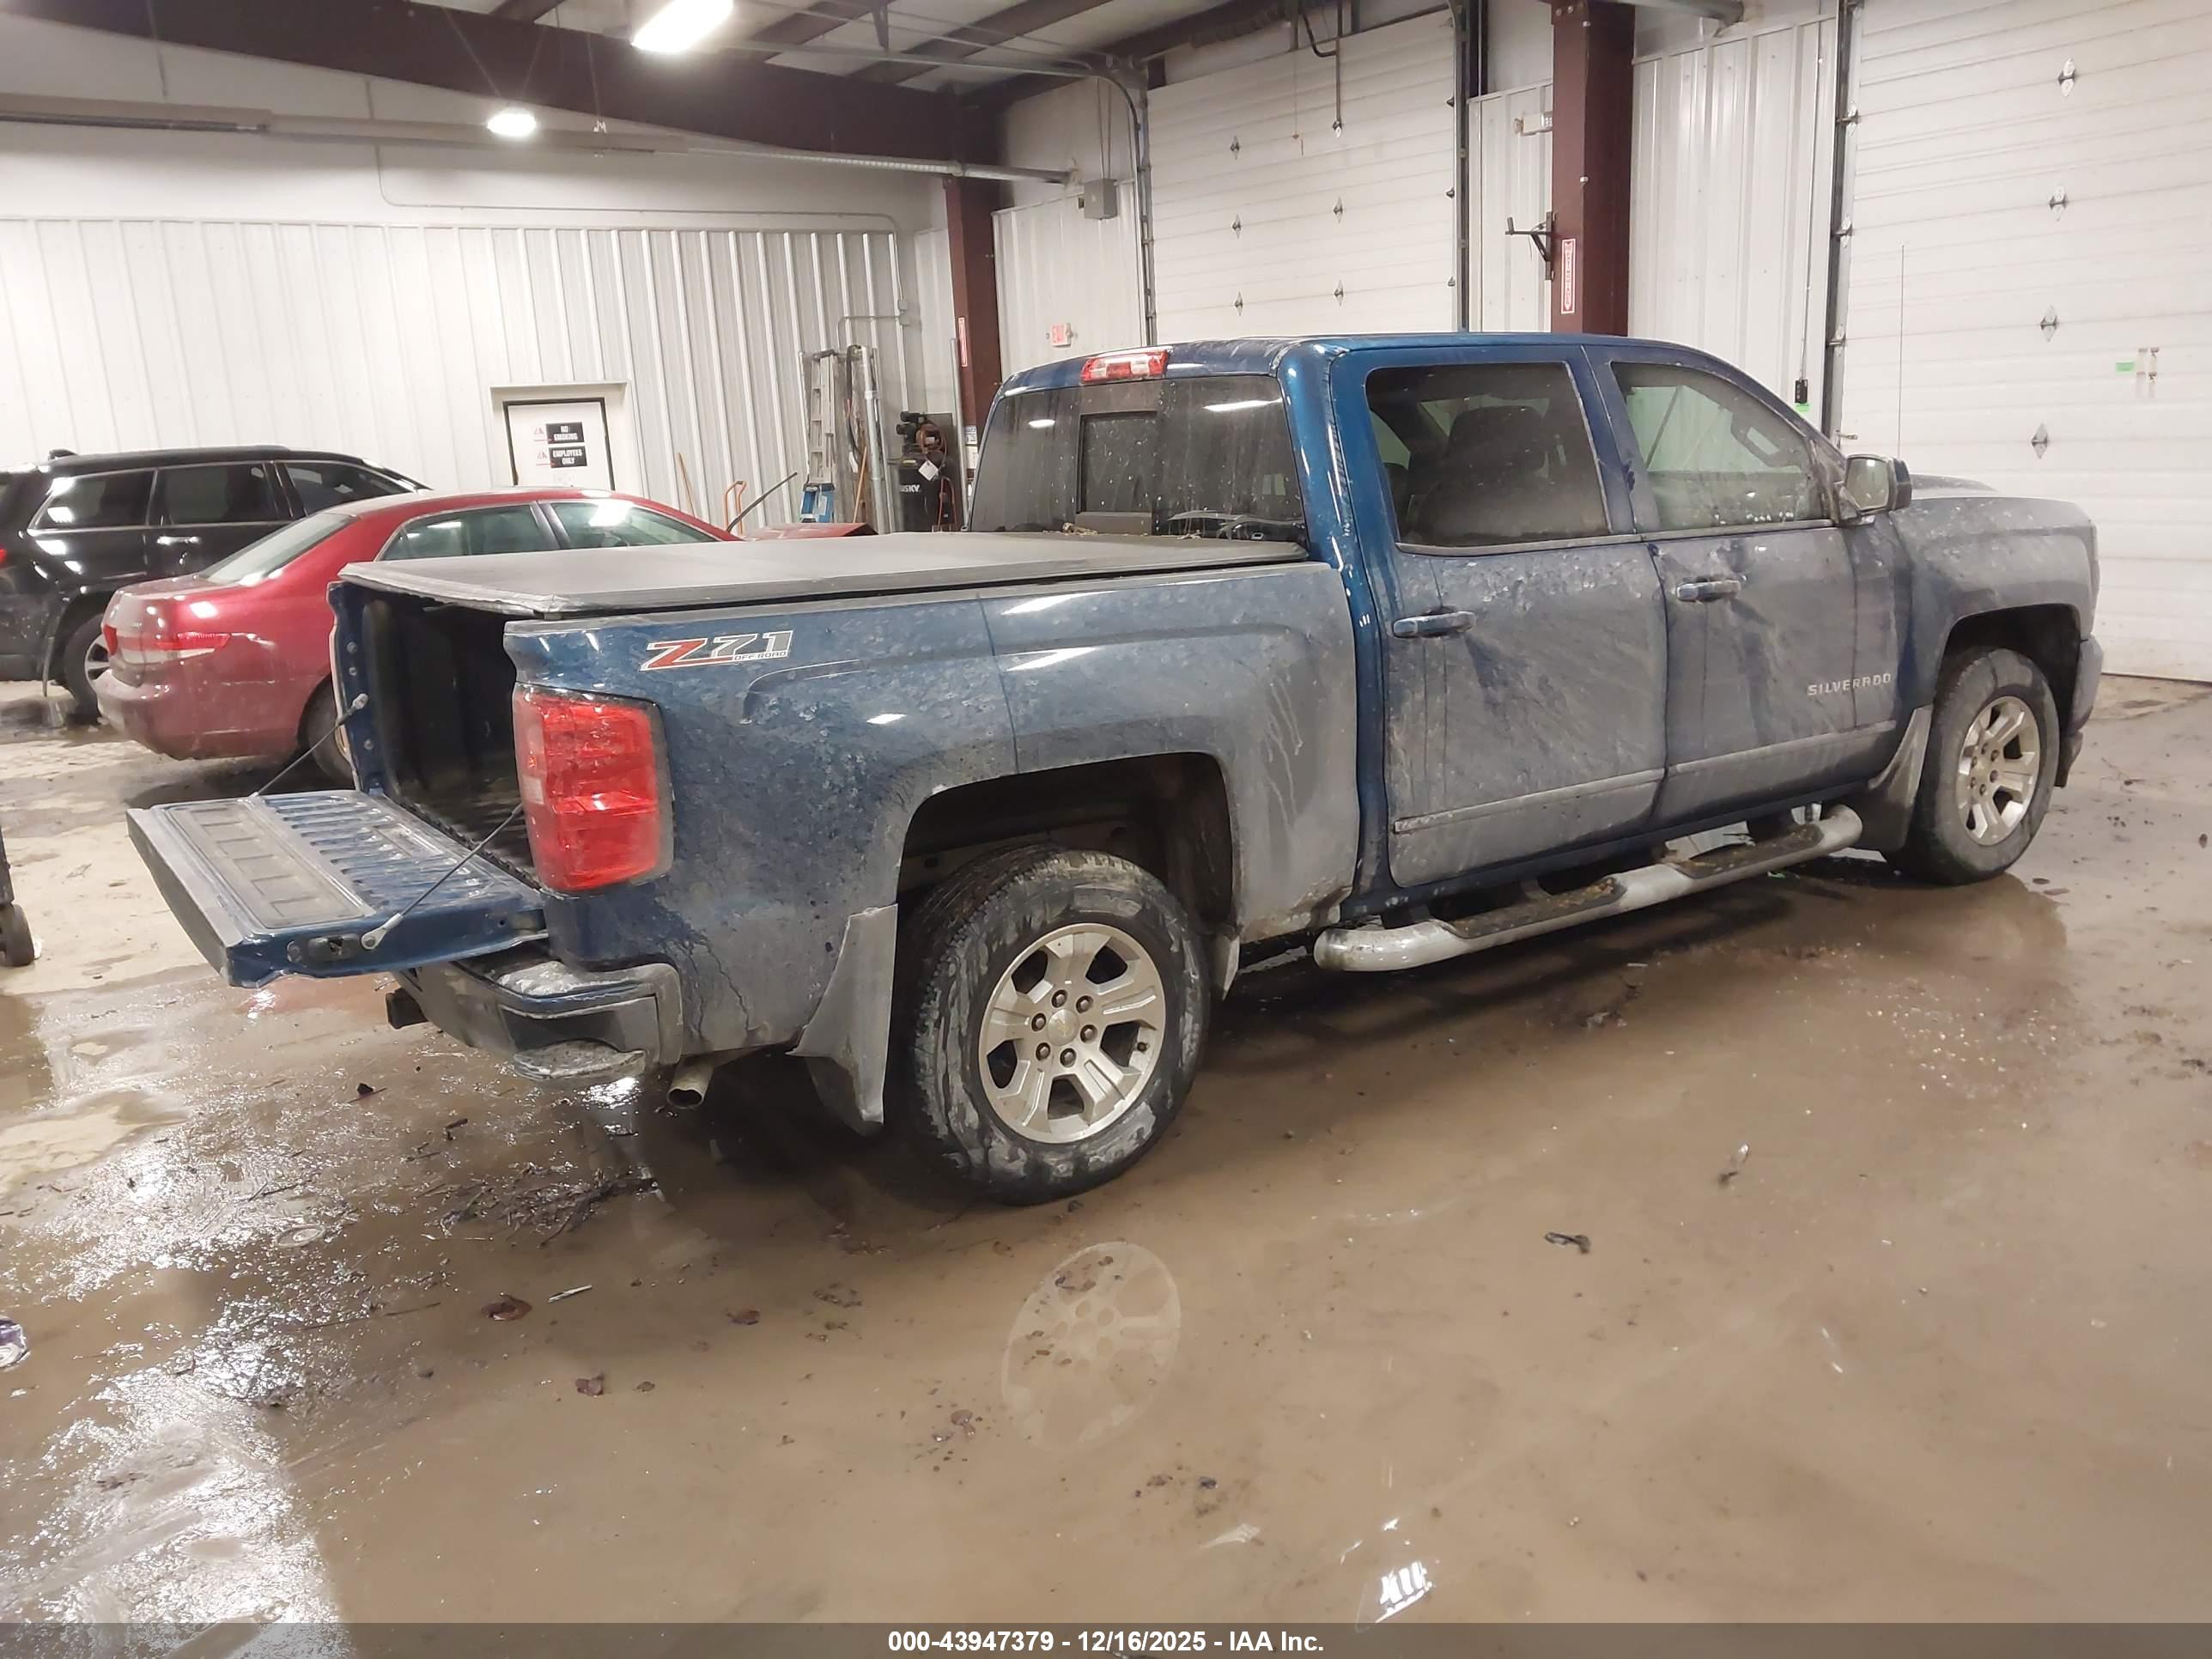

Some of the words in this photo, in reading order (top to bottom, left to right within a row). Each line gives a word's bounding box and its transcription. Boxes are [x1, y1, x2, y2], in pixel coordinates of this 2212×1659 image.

[552, 449, 582, 458] EMPLOYEES
[562, 457, 574, 465] ONLY
[639, 630, 793, 672] Z71
[757, 651, 787, 659] ROAD
[1807, 672, 1892, 696] SILVERADO
